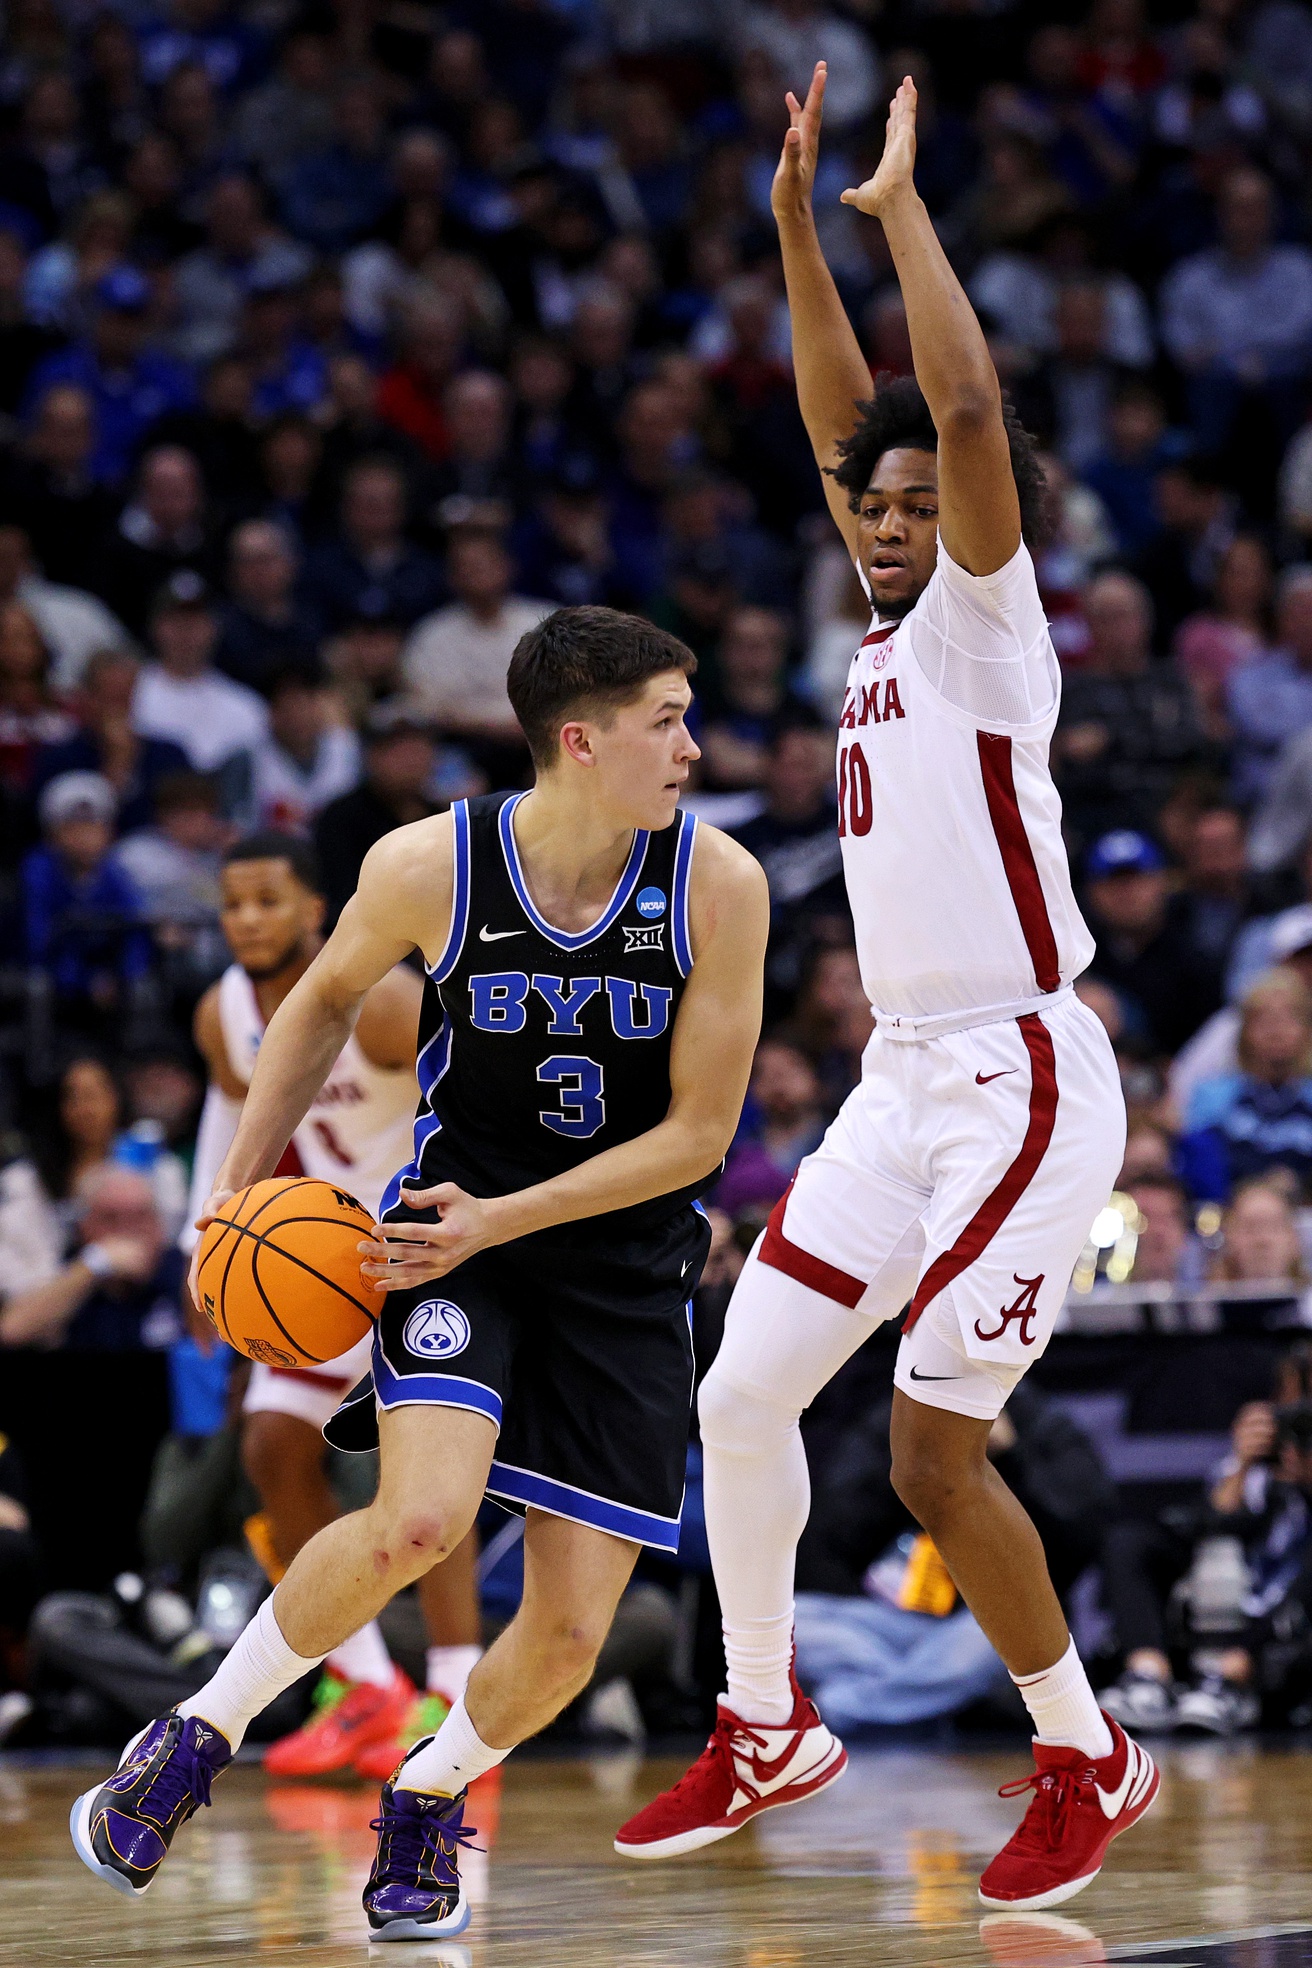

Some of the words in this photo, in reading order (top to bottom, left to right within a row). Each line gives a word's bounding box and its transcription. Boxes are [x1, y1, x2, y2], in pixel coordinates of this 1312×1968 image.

[838, 677, 906, 729] AMA
[838, 742, 873, 837] 10
[640, 901, 665, 911] NCAA
[468, 971, 672, 1039] BYU
[536, 1055, 605, 1138] 3
[424, 1334, 447, 1349] Y
[974, 1272, 1046, 1346] A
